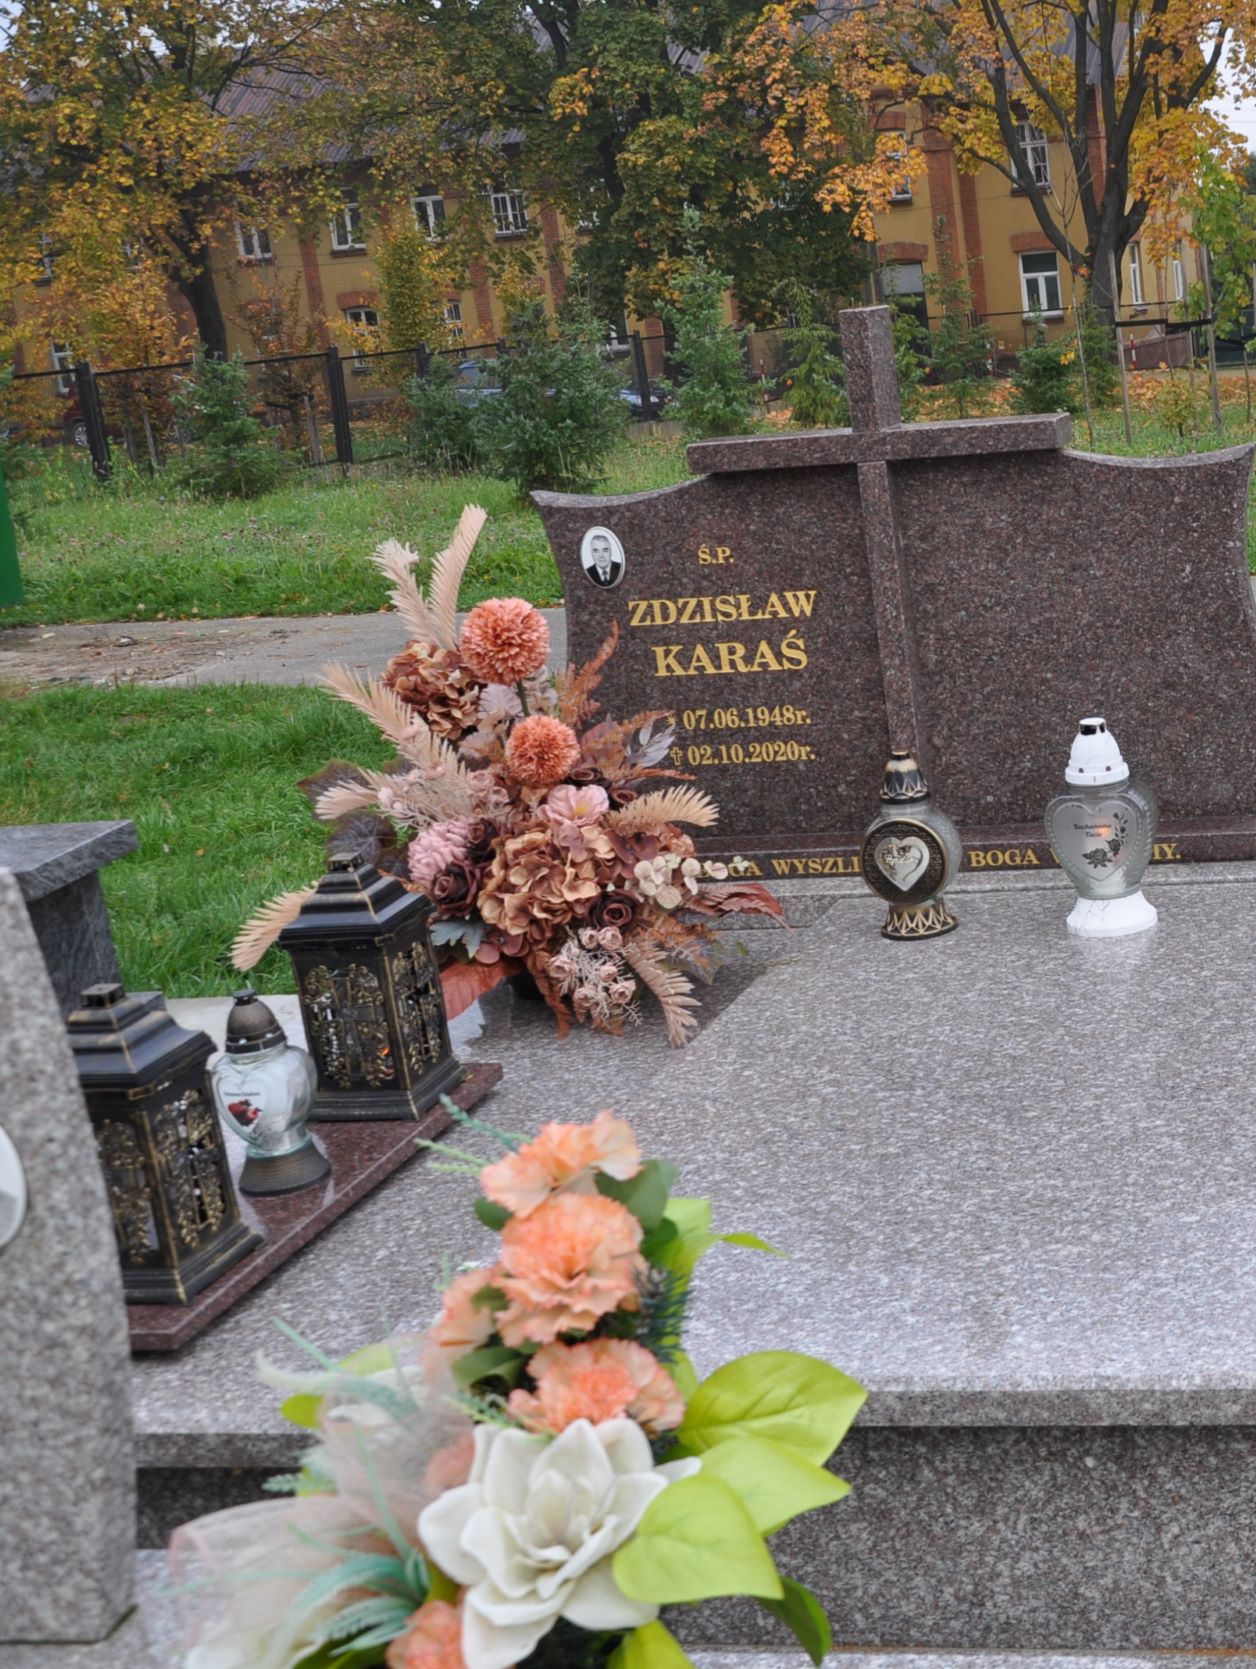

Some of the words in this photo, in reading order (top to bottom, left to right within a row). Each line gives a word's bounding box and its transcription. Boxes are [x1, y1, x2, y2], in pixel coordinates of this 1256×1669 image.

[697, 543, 735, 565] Ś.P.
[628, 589, 818, 627] ZDZISŁAW
[651, 629, 809, 677] KARAŚ
[682, 704, 812, 731] 07.06.1948r.
[687, 740, 816, 766] 02.10.2020r.
[696, 861, 763, 879] BGA
[771, 856, 862, 876] WYSZLI
[968, 848, 1040, 868] BOGA
